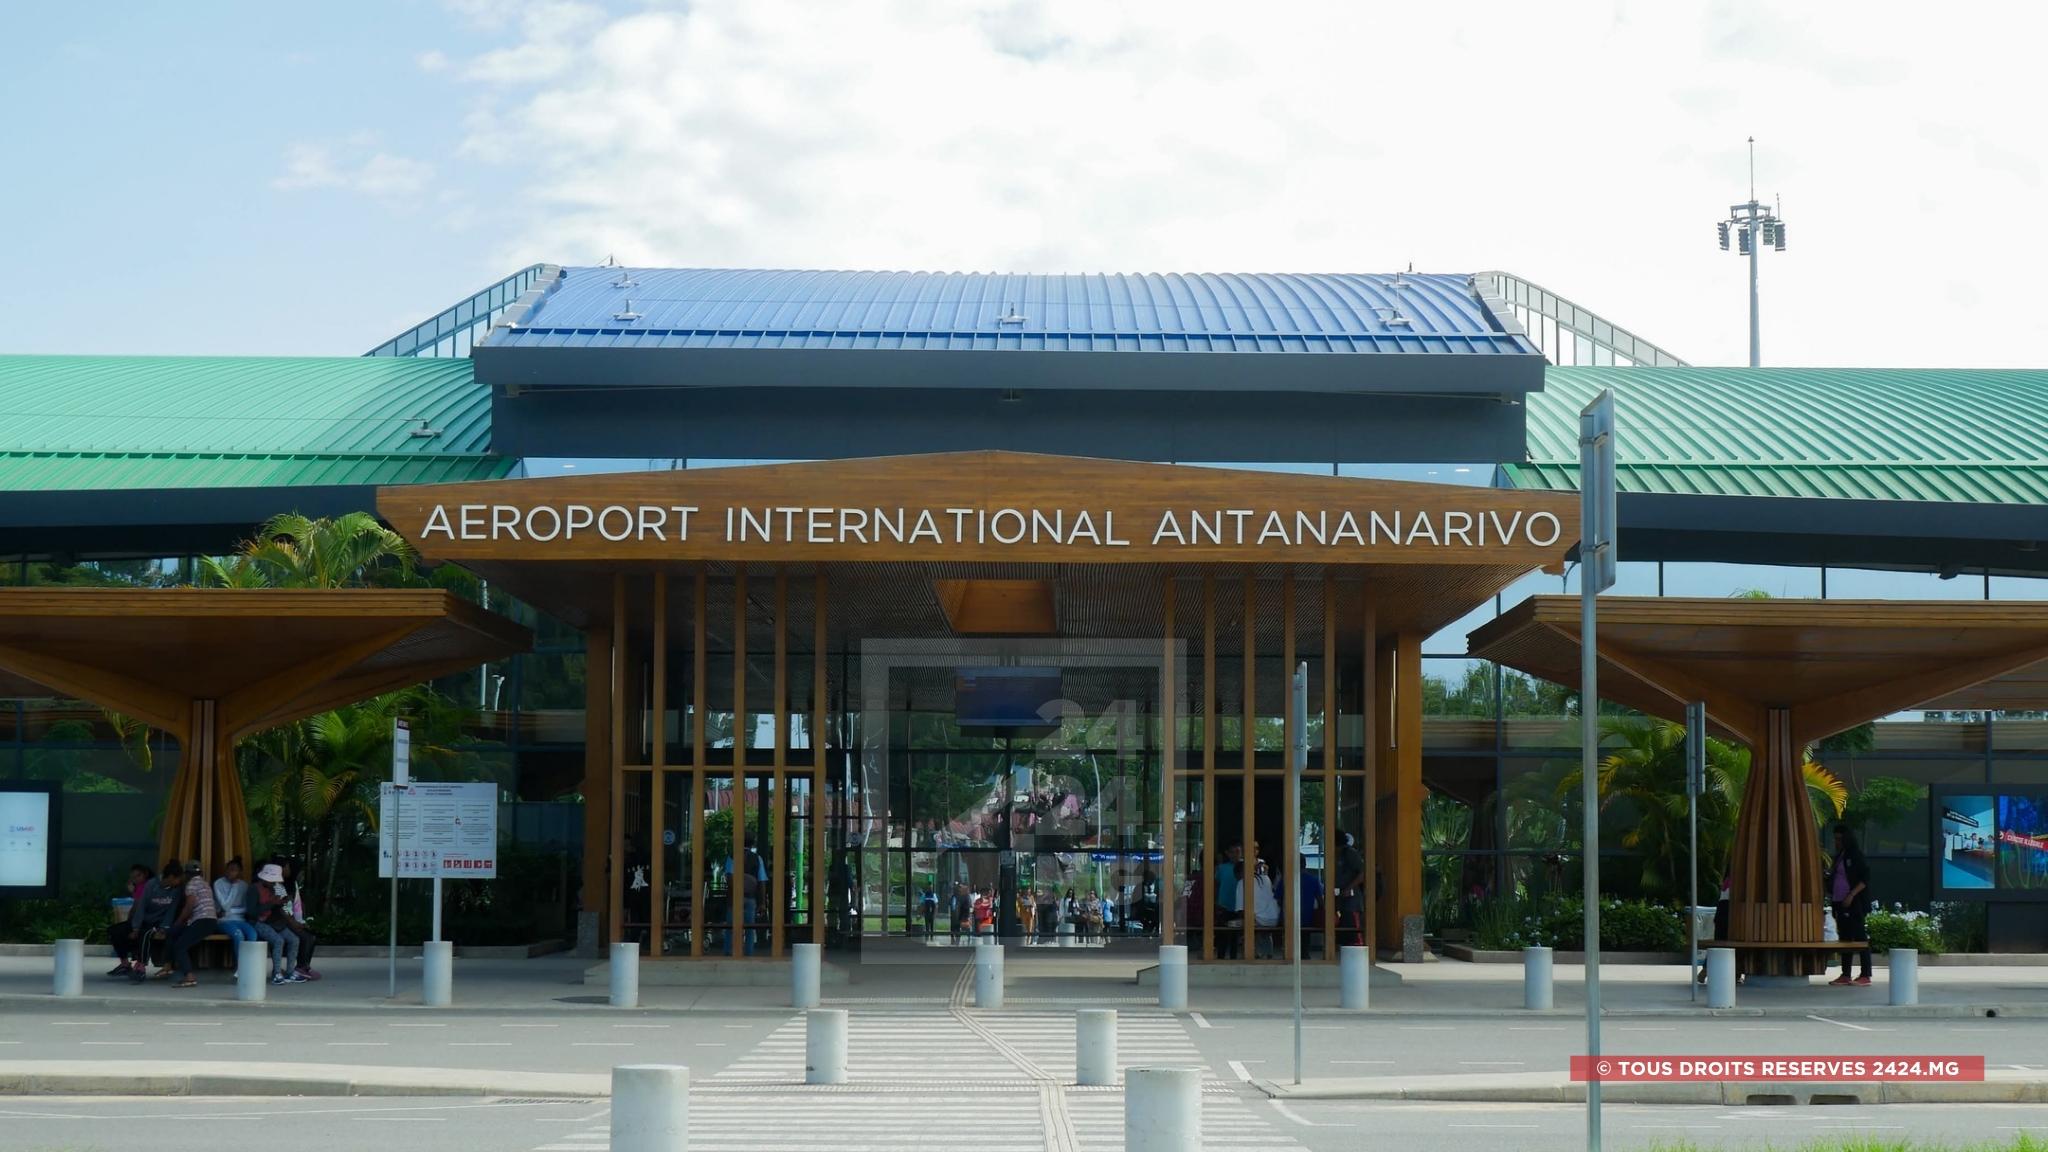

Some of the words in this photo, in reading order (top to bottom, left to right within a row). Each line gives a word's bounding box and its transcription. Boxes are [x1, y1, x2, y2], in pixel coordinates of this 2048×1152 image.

[421, 504, 699, 542] AEROPORT
[725, 507, 1130, 546] INTERNATIONAL
[1152, 509, 1561, 547] ANTANANARIVO
